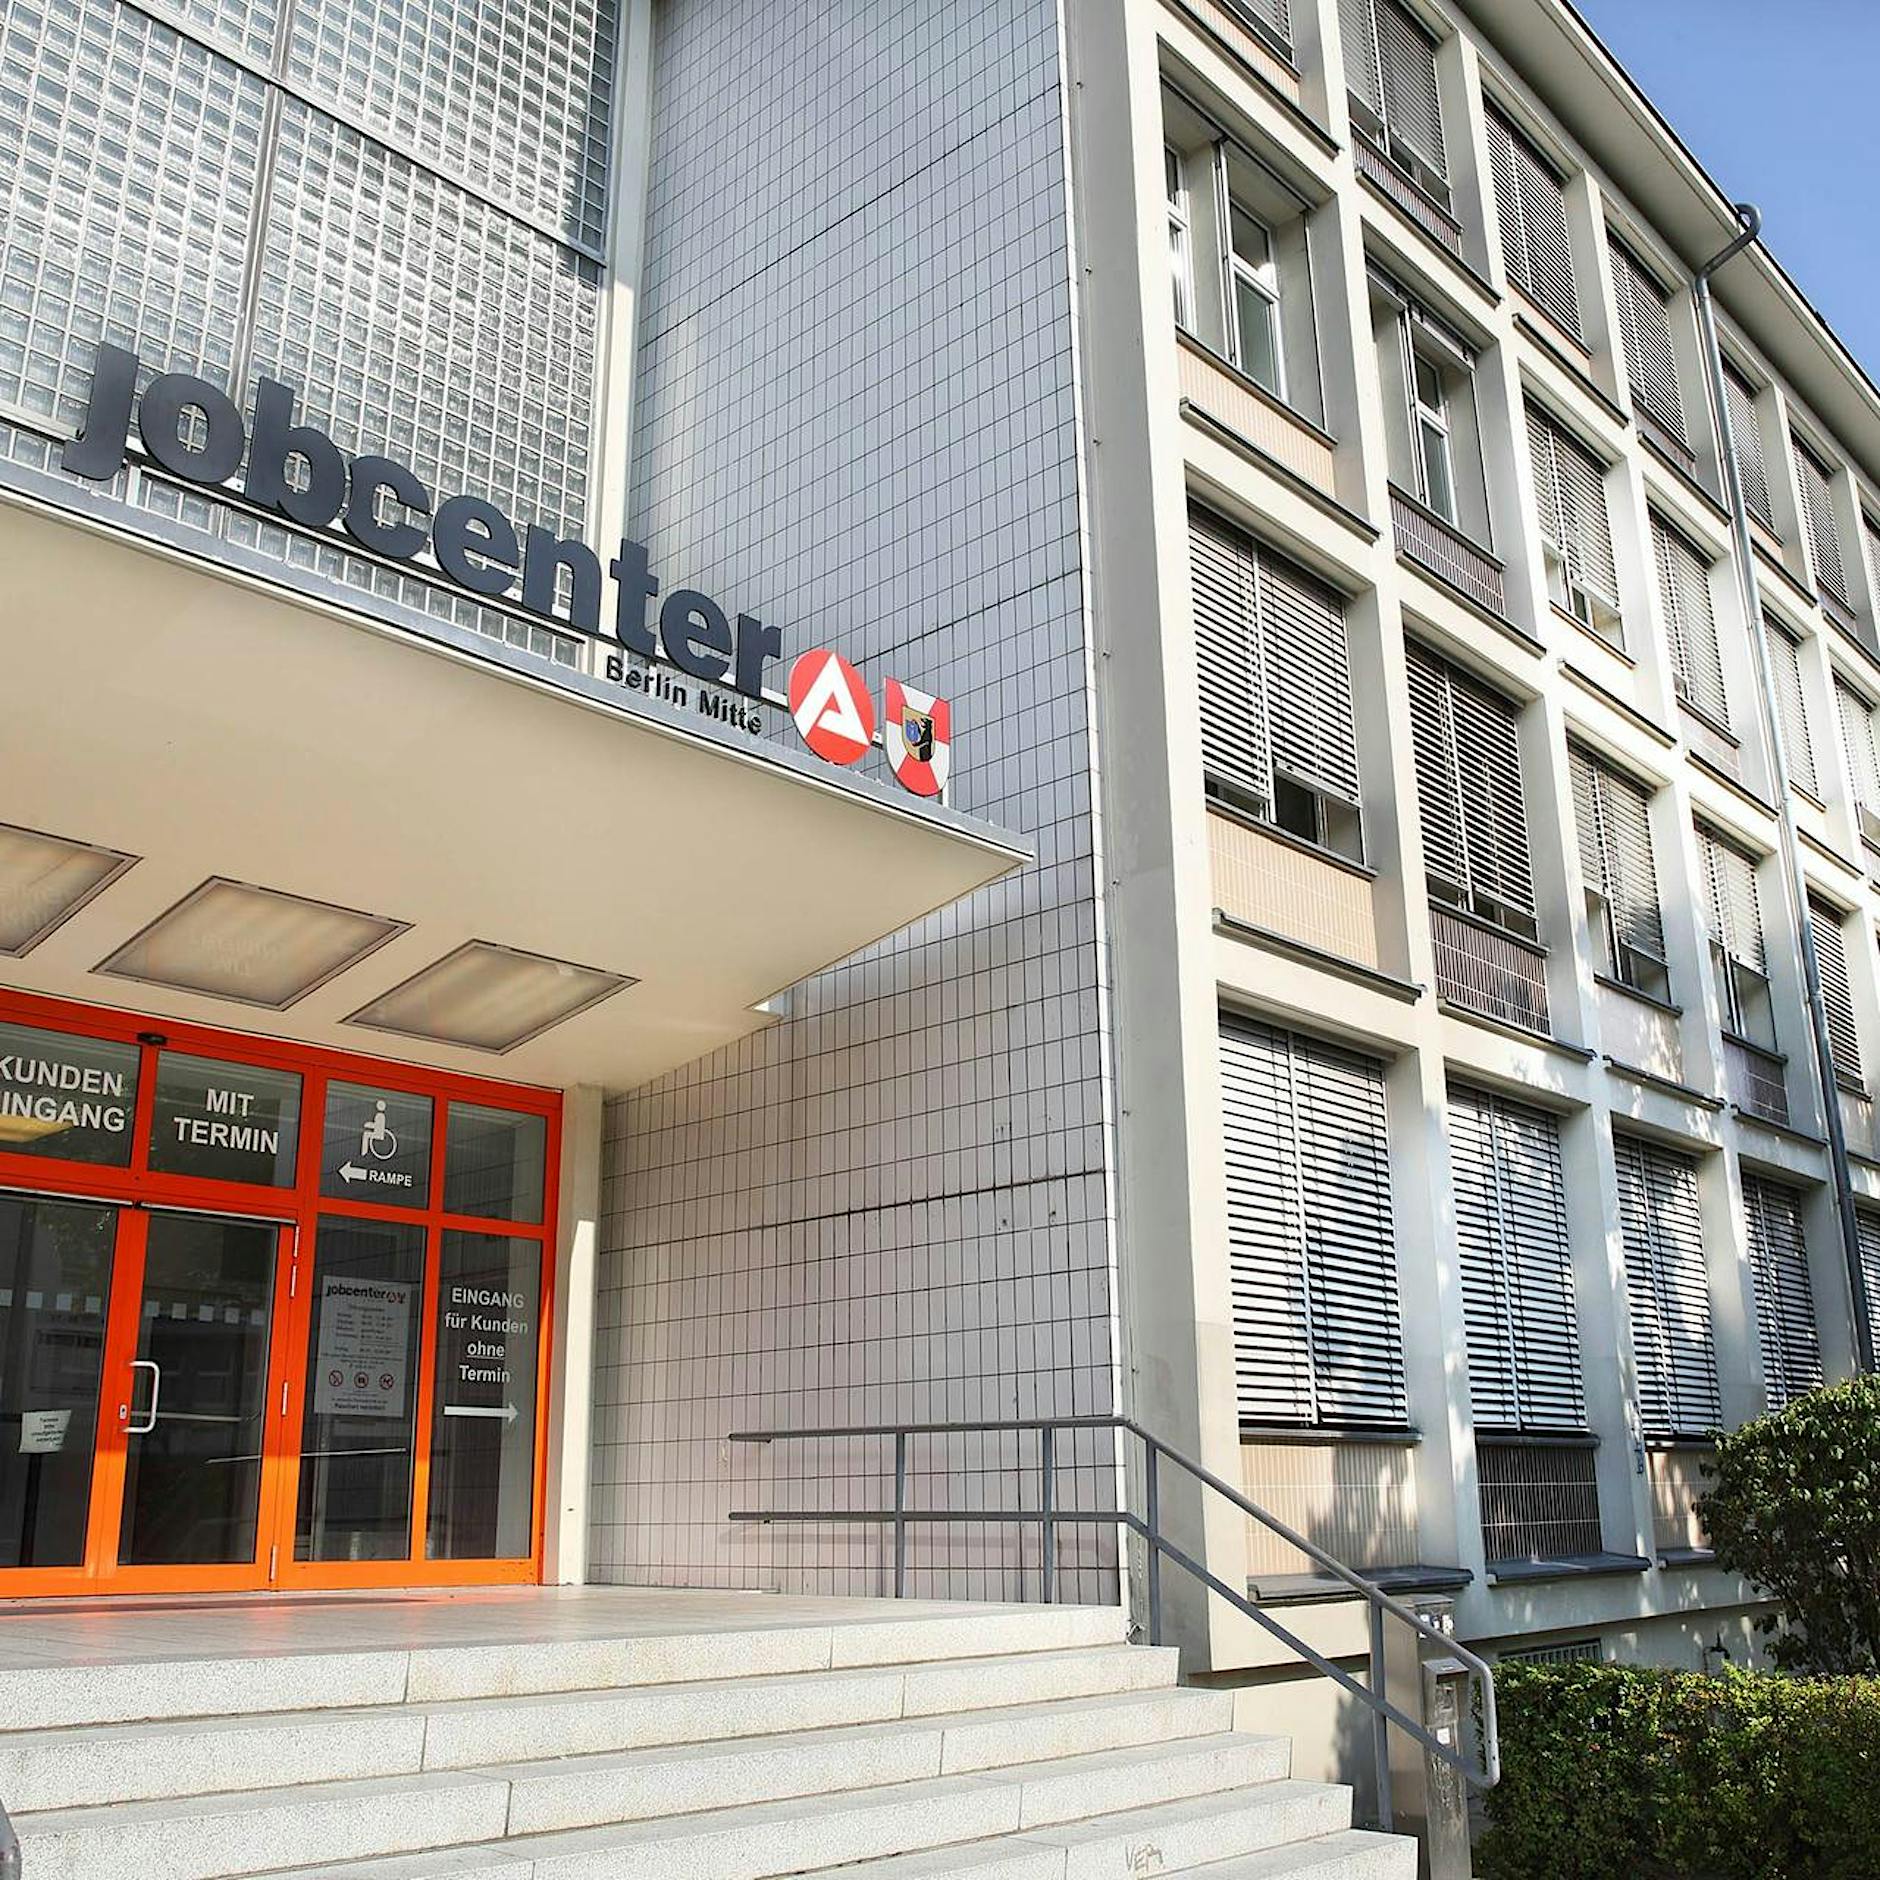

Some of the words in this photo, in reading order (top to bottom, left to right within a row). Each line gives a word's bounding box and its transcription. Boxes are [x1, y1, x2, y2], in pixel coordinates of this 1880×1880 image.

[606, 655, 688, 707] Berlin
[699, 690, 763, 737] Mitte
[206, 1088, 254, 1117] MIT
[174, 1117, 279, 1154] TERMIN
[369, 1169, 413, 1188] RAMPE
[451, 1287, 525, 1309] EINGANG
[445, 1312, 467, 1329] für
[471, 1315, 529, 1335] Kunden
[467, 1340, 505, 1359] ohne
[459, 1364, 511, 1384] Termin
